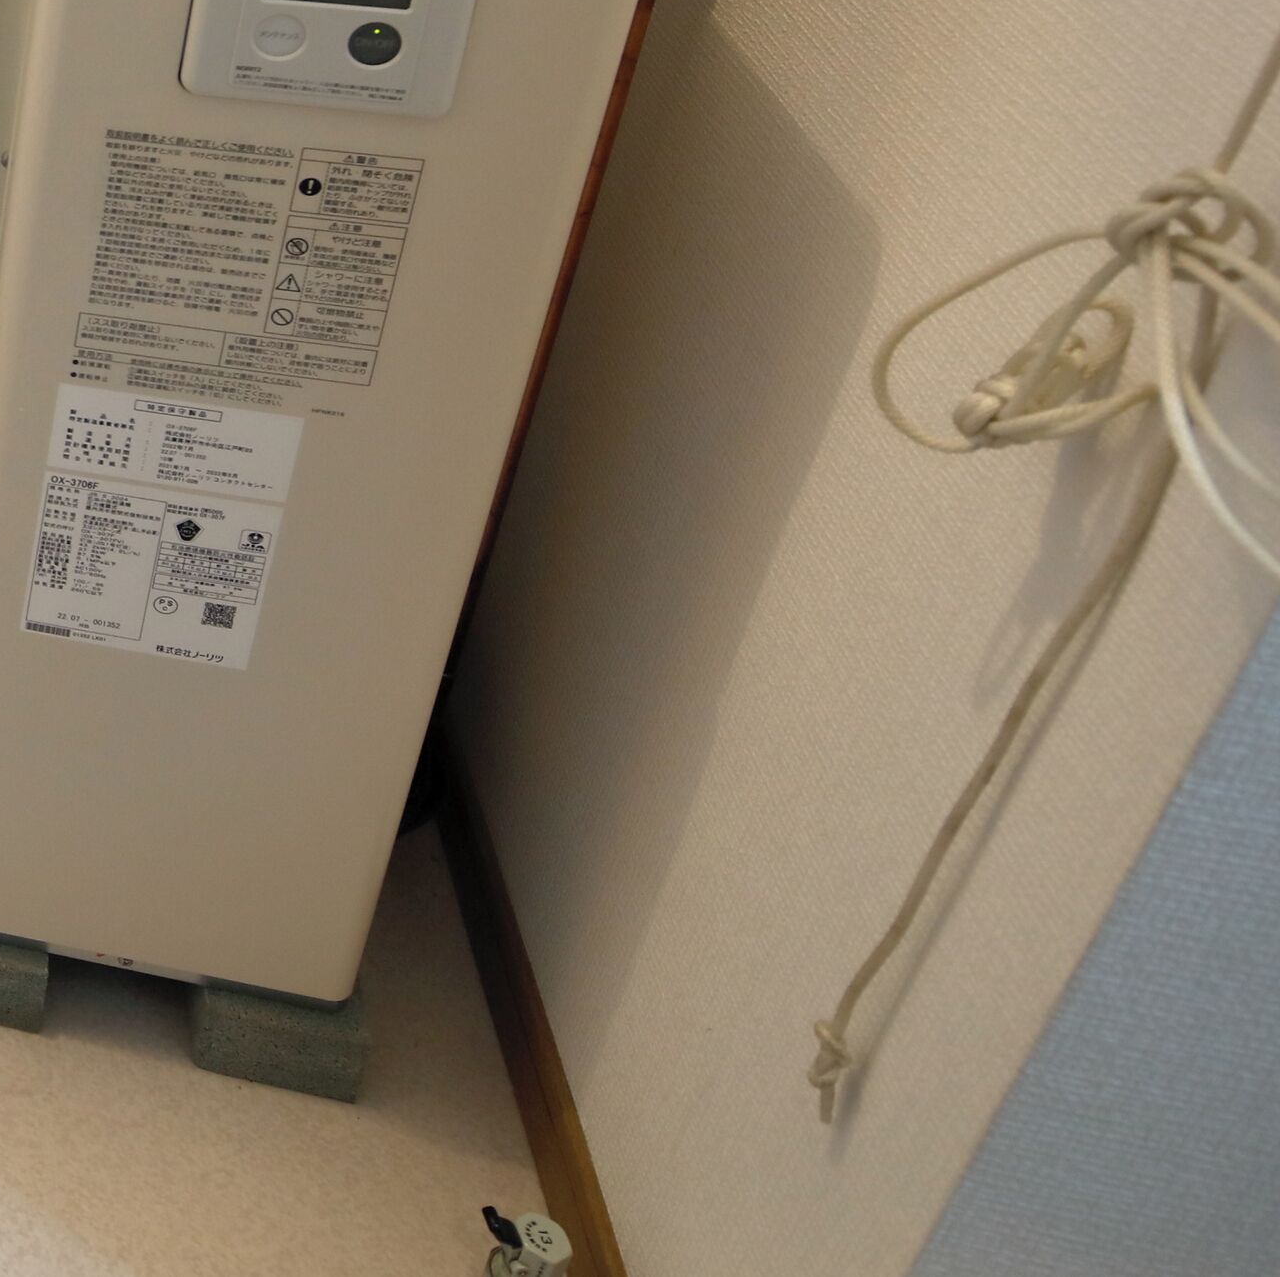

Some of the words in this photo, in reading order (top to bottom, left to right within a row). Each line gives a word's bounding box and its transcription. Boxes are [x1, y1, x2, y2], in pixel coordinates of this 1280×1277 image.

[50, 475, 99, 490] OX-3706F
[92, 618, 120, 629] 001352
[155, 644, 224, 663] 株式会社ノーリツ
